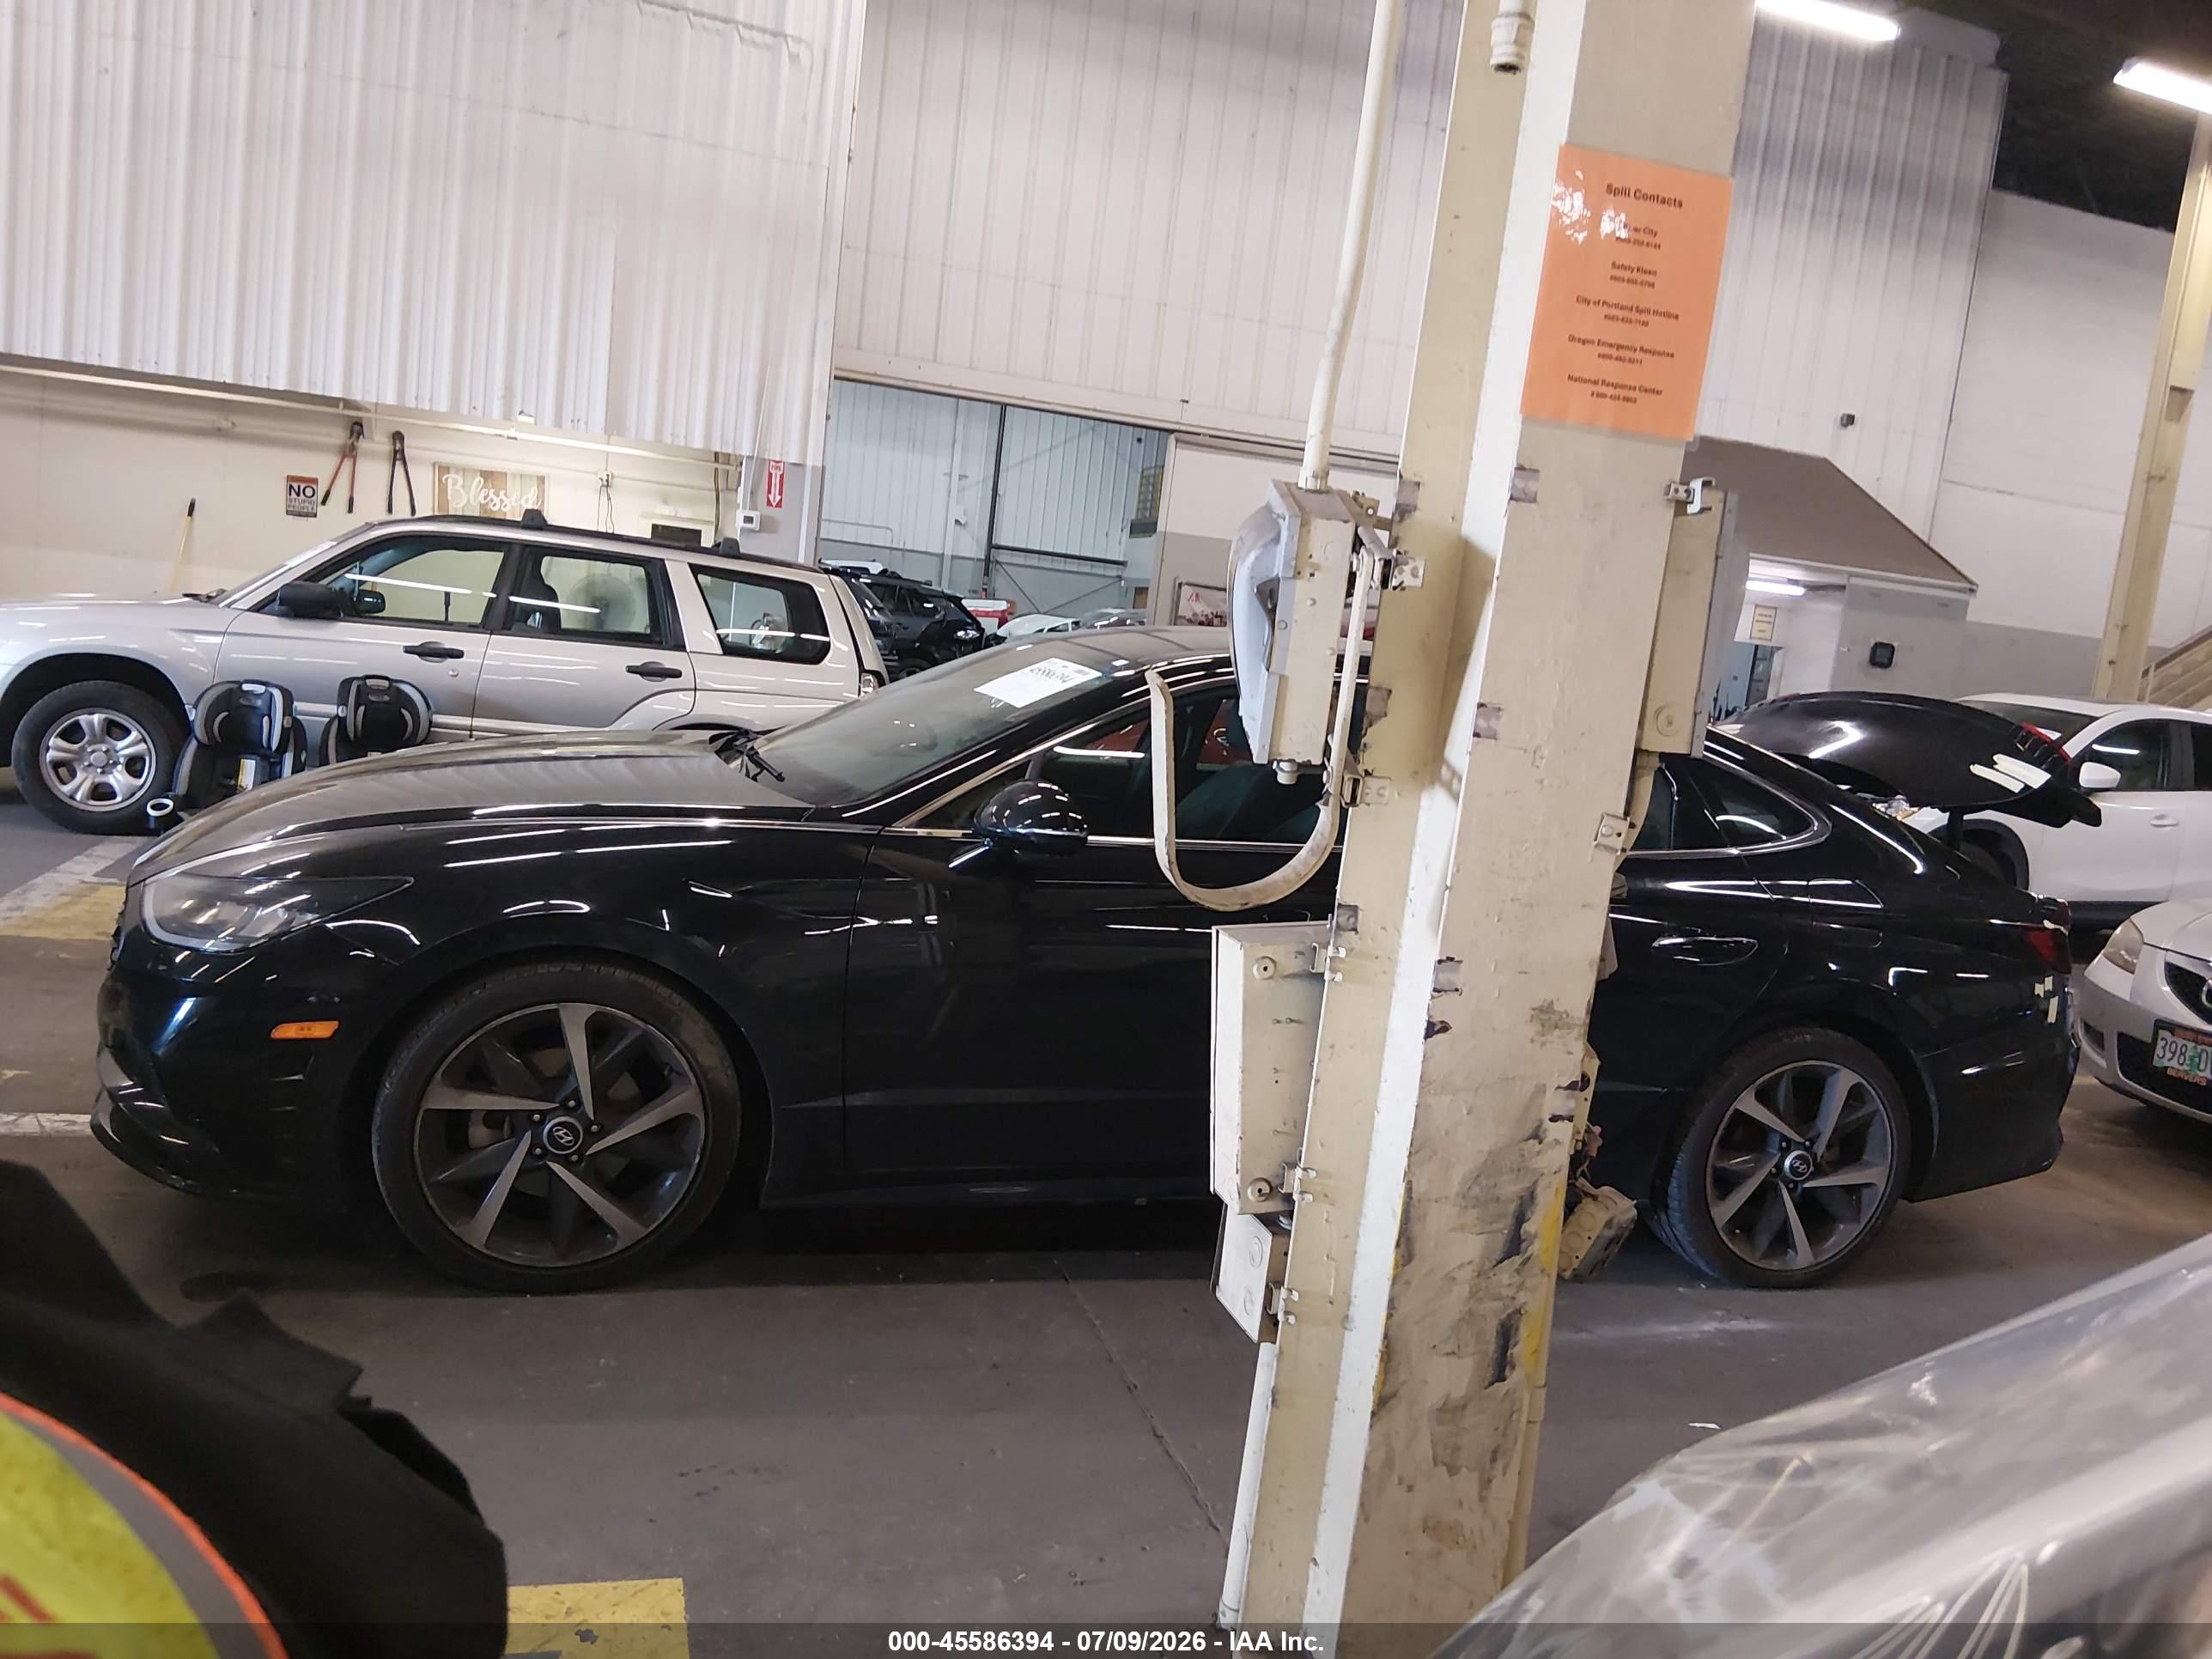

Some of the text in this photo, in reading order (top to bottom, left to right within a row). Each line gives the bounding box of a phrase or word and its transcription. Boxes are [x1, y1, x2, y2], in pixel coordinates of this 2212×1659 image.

[1606, 182, 1683, 208] Spill Contacts
[1643, 227, 1658, 239] City
[1611, 260, 1635, 274] Safety
[1576, 295, 1679, 320] City of Portland Spill Hotline
[1567, 333, 1674, 359] Oregon Emergency Response
[1567, 374, 1663, 396] National Response Center
[289, 483, 316, 499] NO
[442, 473, 542, 512] Blessed
[2156, 1037, 2188, 1066] 398
